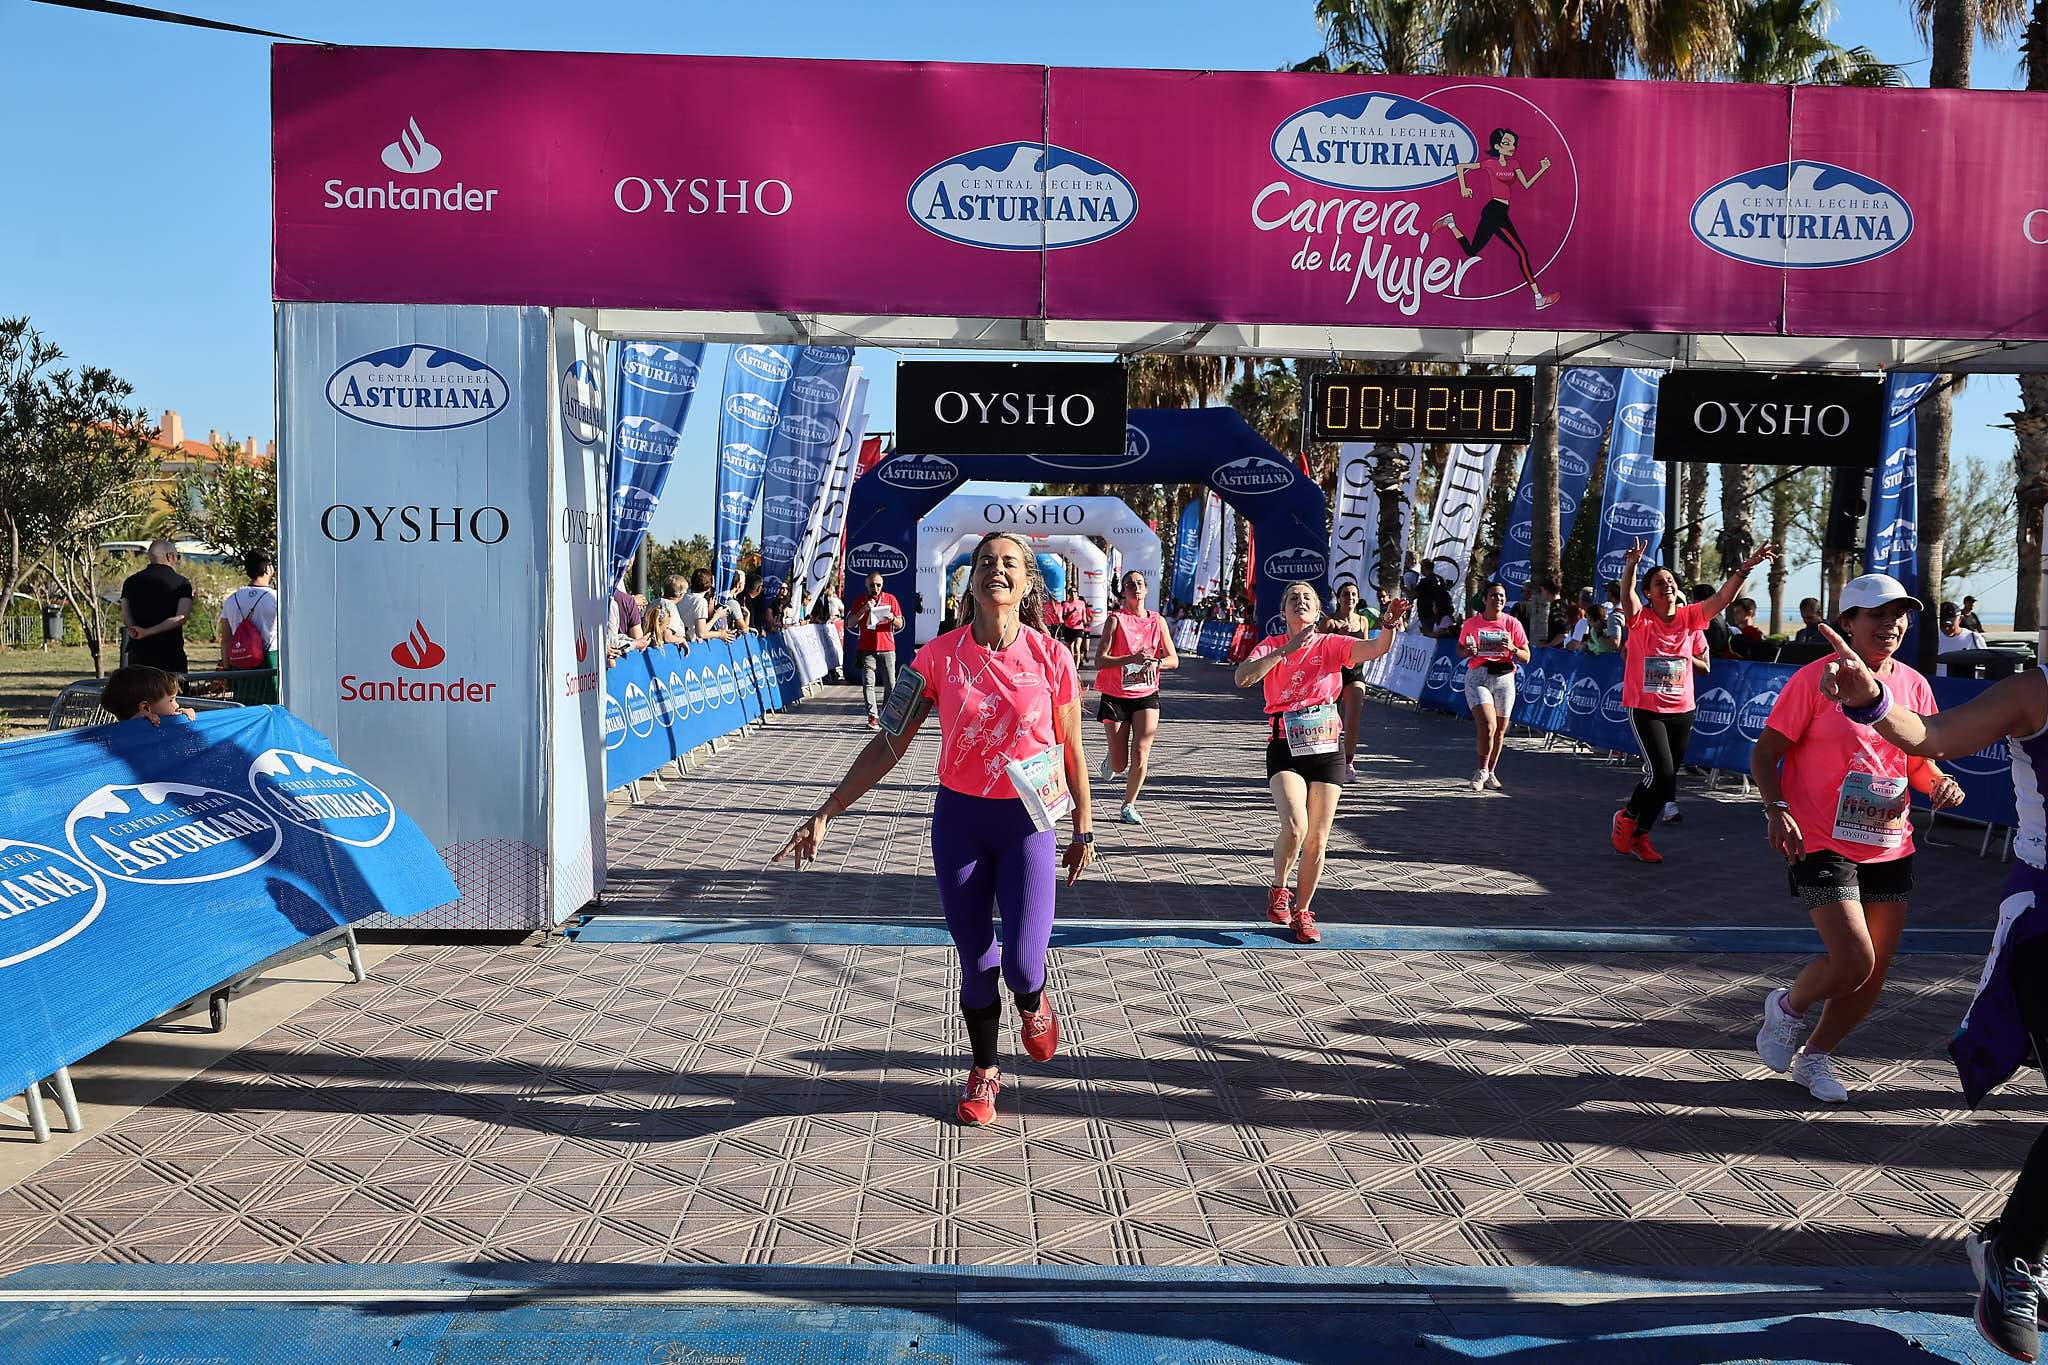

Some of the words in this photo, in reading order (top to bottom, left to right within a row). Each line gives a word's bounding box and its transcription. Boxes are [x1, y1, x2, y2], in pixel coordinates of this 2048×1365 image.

[1286, 126, 1460, 167] ASTURIANA
[1319, 125, 1384, 136] CENTRAL
[1390, 127, 1456, 138] LECHERA
[324, 179, 498, 211] Santander
[614, 176, 793, 216] OYSHO
[925, 180, 1120, 222] ASTURIANA
[961, 178, 1033, 190] CENTRAL
[1251, 181, 1421, 236] Carrera
[1706, 198, 1896, 241] ASTURIANA
[1742, 197, 1812, 208] CENTRAL
[1818, 199, 1890, 209] LECHERA
[1291, 236, 1323, 271] de
[1329, 236, 1352, 272] la
[1346, 232, 1482, 316] Mujer
[368, 373, 426, 383] CENTRAL
[432, 375, 490, 384] LECHERA
[739, 350, 788, 379] ASTURIANA
[340, 375, 496, 410] ASTURIANA
[934, 391, 1095, 427] OYSHO
[1326, 386, 1516, 432] 00:42:40
[1560, 415, 1597, 436] STURIANA
[1694, 401, 1850, 437] OYSHO
[883, 465, 952, 480] ASTURIANA
[1219, 472, 1289, 486] ASTURIANA
[321, 504, 510, 544] OYSHO
[983, 503, 1085, 525] OYSHO
[849, 554, 904, 569] ASTURIANA
[1268, 561, 1324, 574] ASTURIANA
[341, 675, 497, 703] Santander
[108, 812, 174, 837] CENTRAL
[170, 796, 231, 818] LECHERA
[266, 786, 389, 821] ASTURIANA
[90, 807, 273, 876] ASTURIANA
